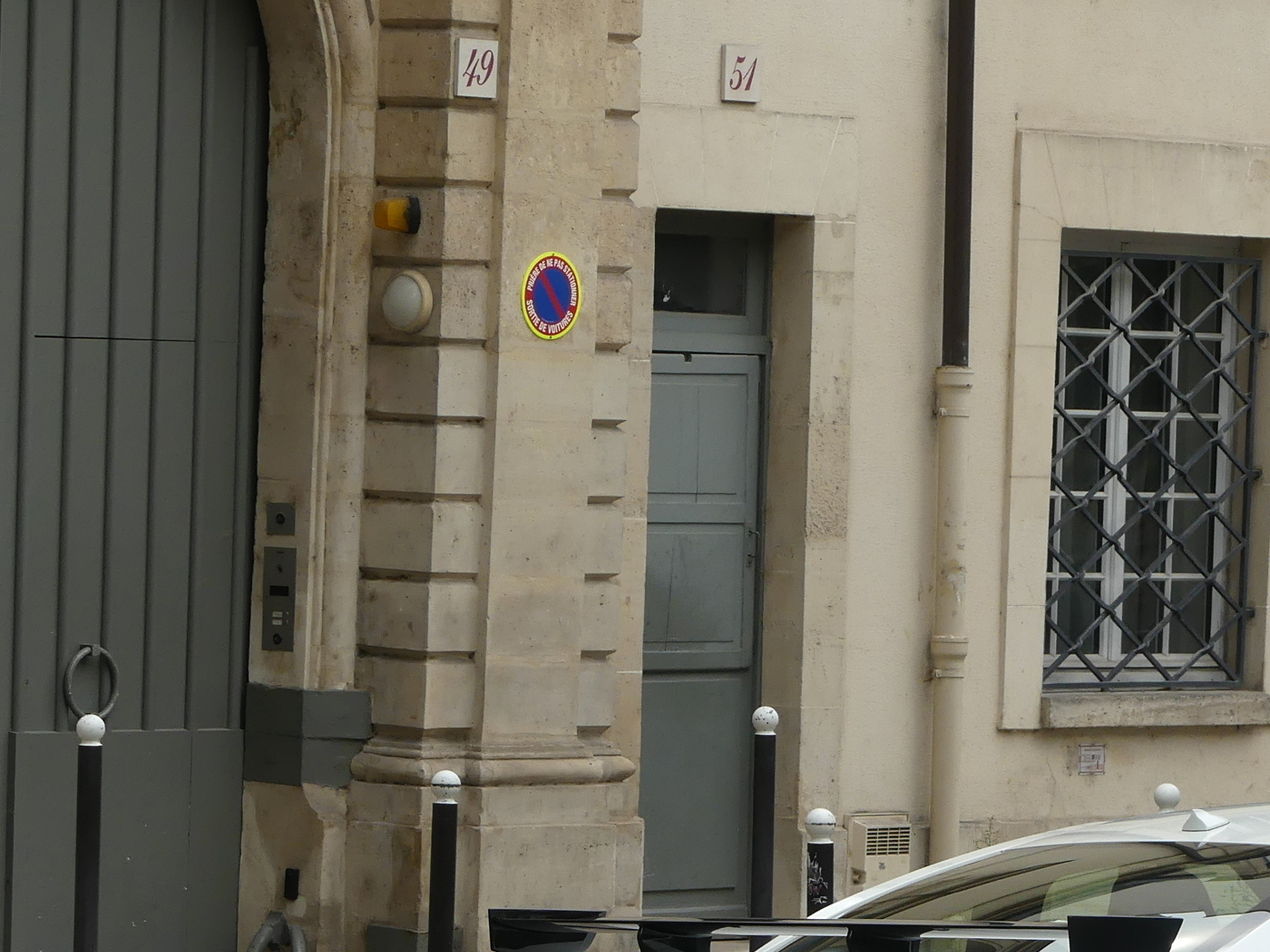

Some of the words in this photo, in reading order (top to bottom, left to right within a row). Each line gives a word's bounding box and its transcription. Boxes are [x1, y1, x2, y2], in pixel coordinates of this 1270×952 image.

[462, 48, 494, 87] 49
[729, 56, 758, 91] 51
[538, 260, 546, 271] DE
[546, 258, 554, 267] NE
[553, 259, 565, 270] PAS
[562, 265, 577, 306] STATIONNER
[526, 299, 540, 327] SORTIE
[538, 321, 547, 332] DE
[547, 310, 573, 334] VOITURES
